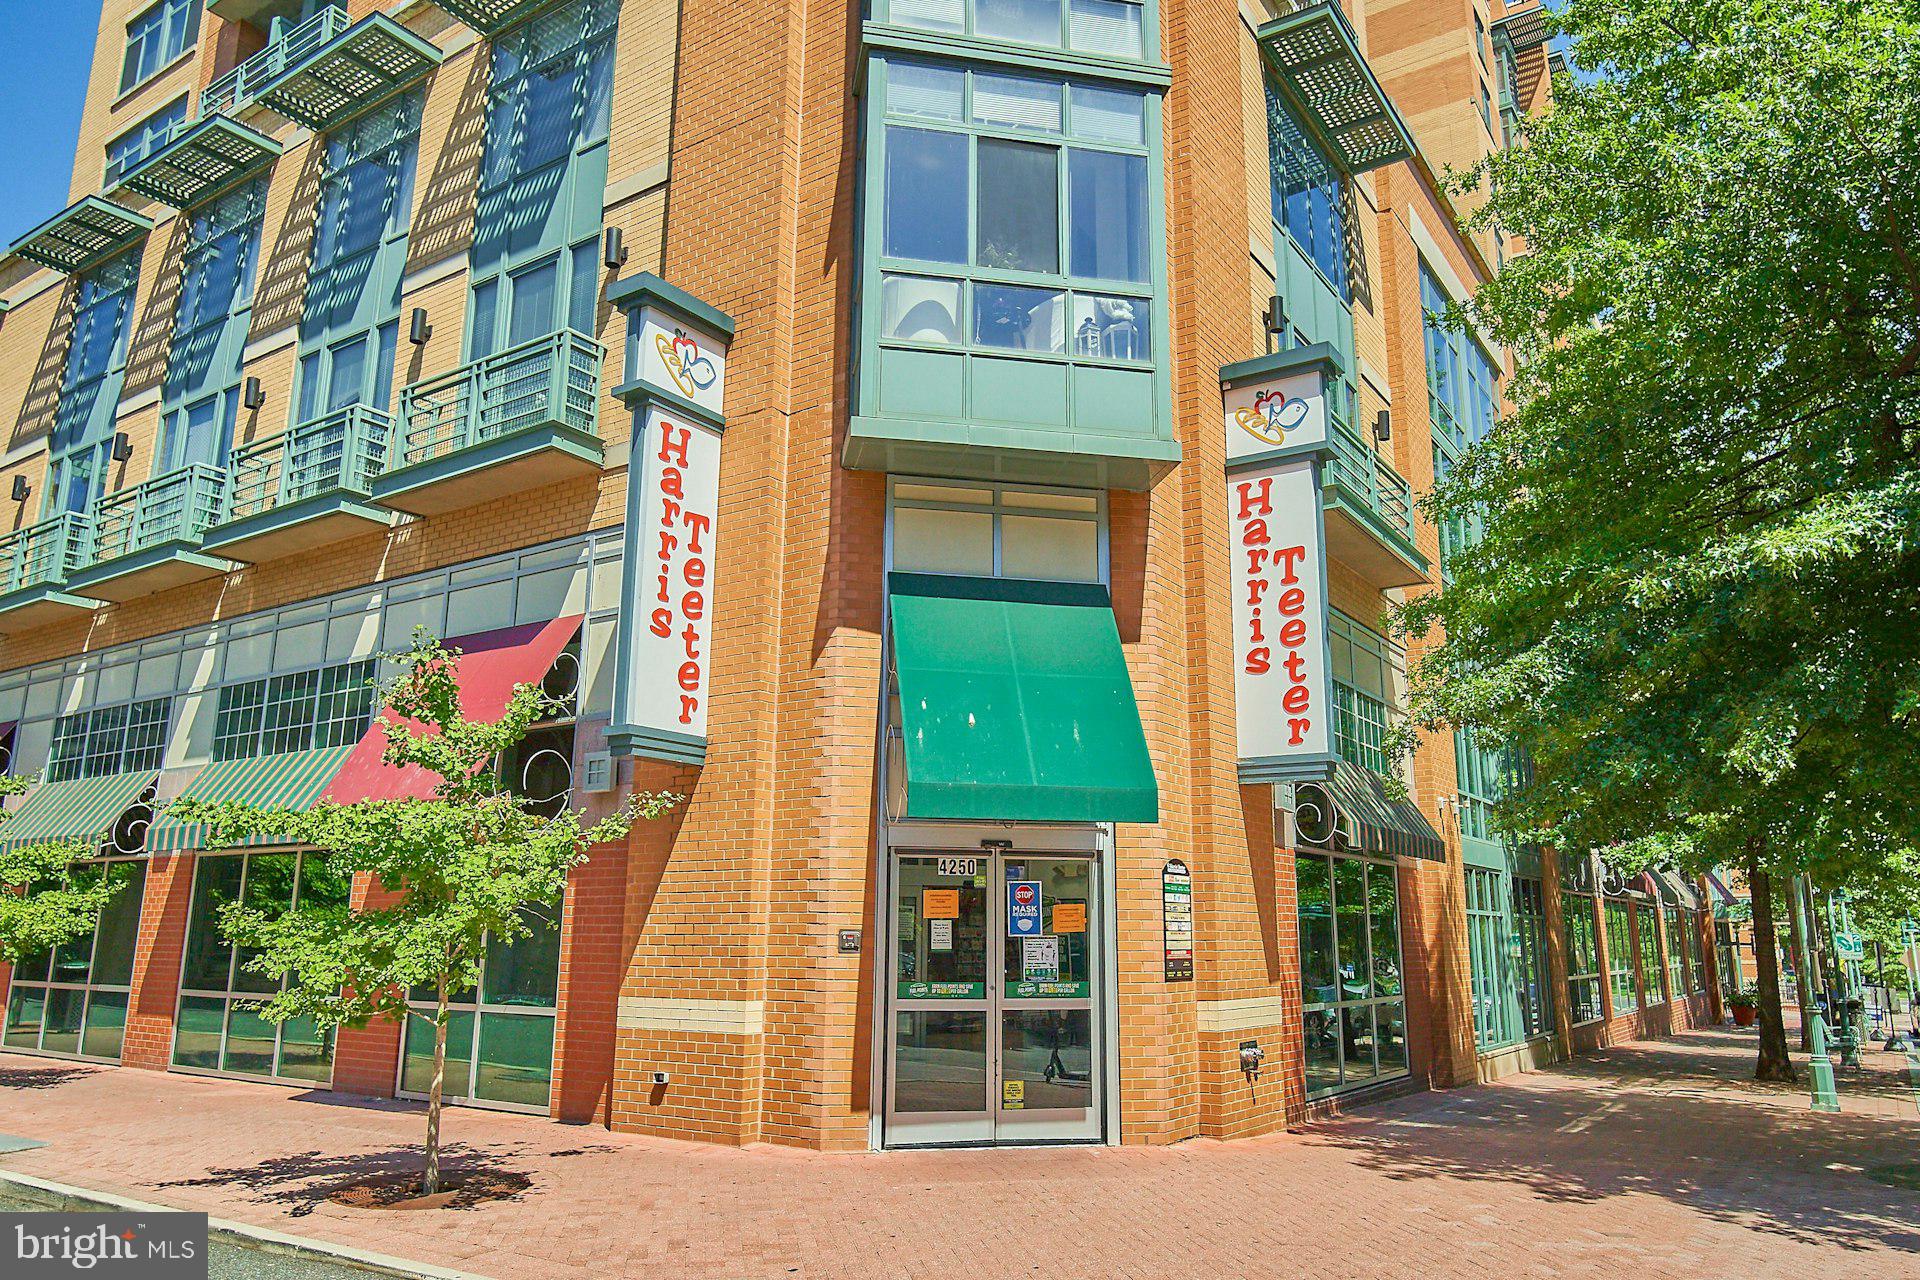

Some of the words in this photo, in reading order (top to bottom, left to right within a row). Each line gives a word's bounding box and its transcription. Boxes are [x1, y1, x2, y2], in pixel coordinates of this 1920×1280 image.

[650, 421, 690, 638] Harris
[678, 511, 709, 724] Teeter
[1237, 477, 1273, 675] Harris
[1273, 545, 1310, 747] Teeter
[939, 859, 975, 875] 4250
